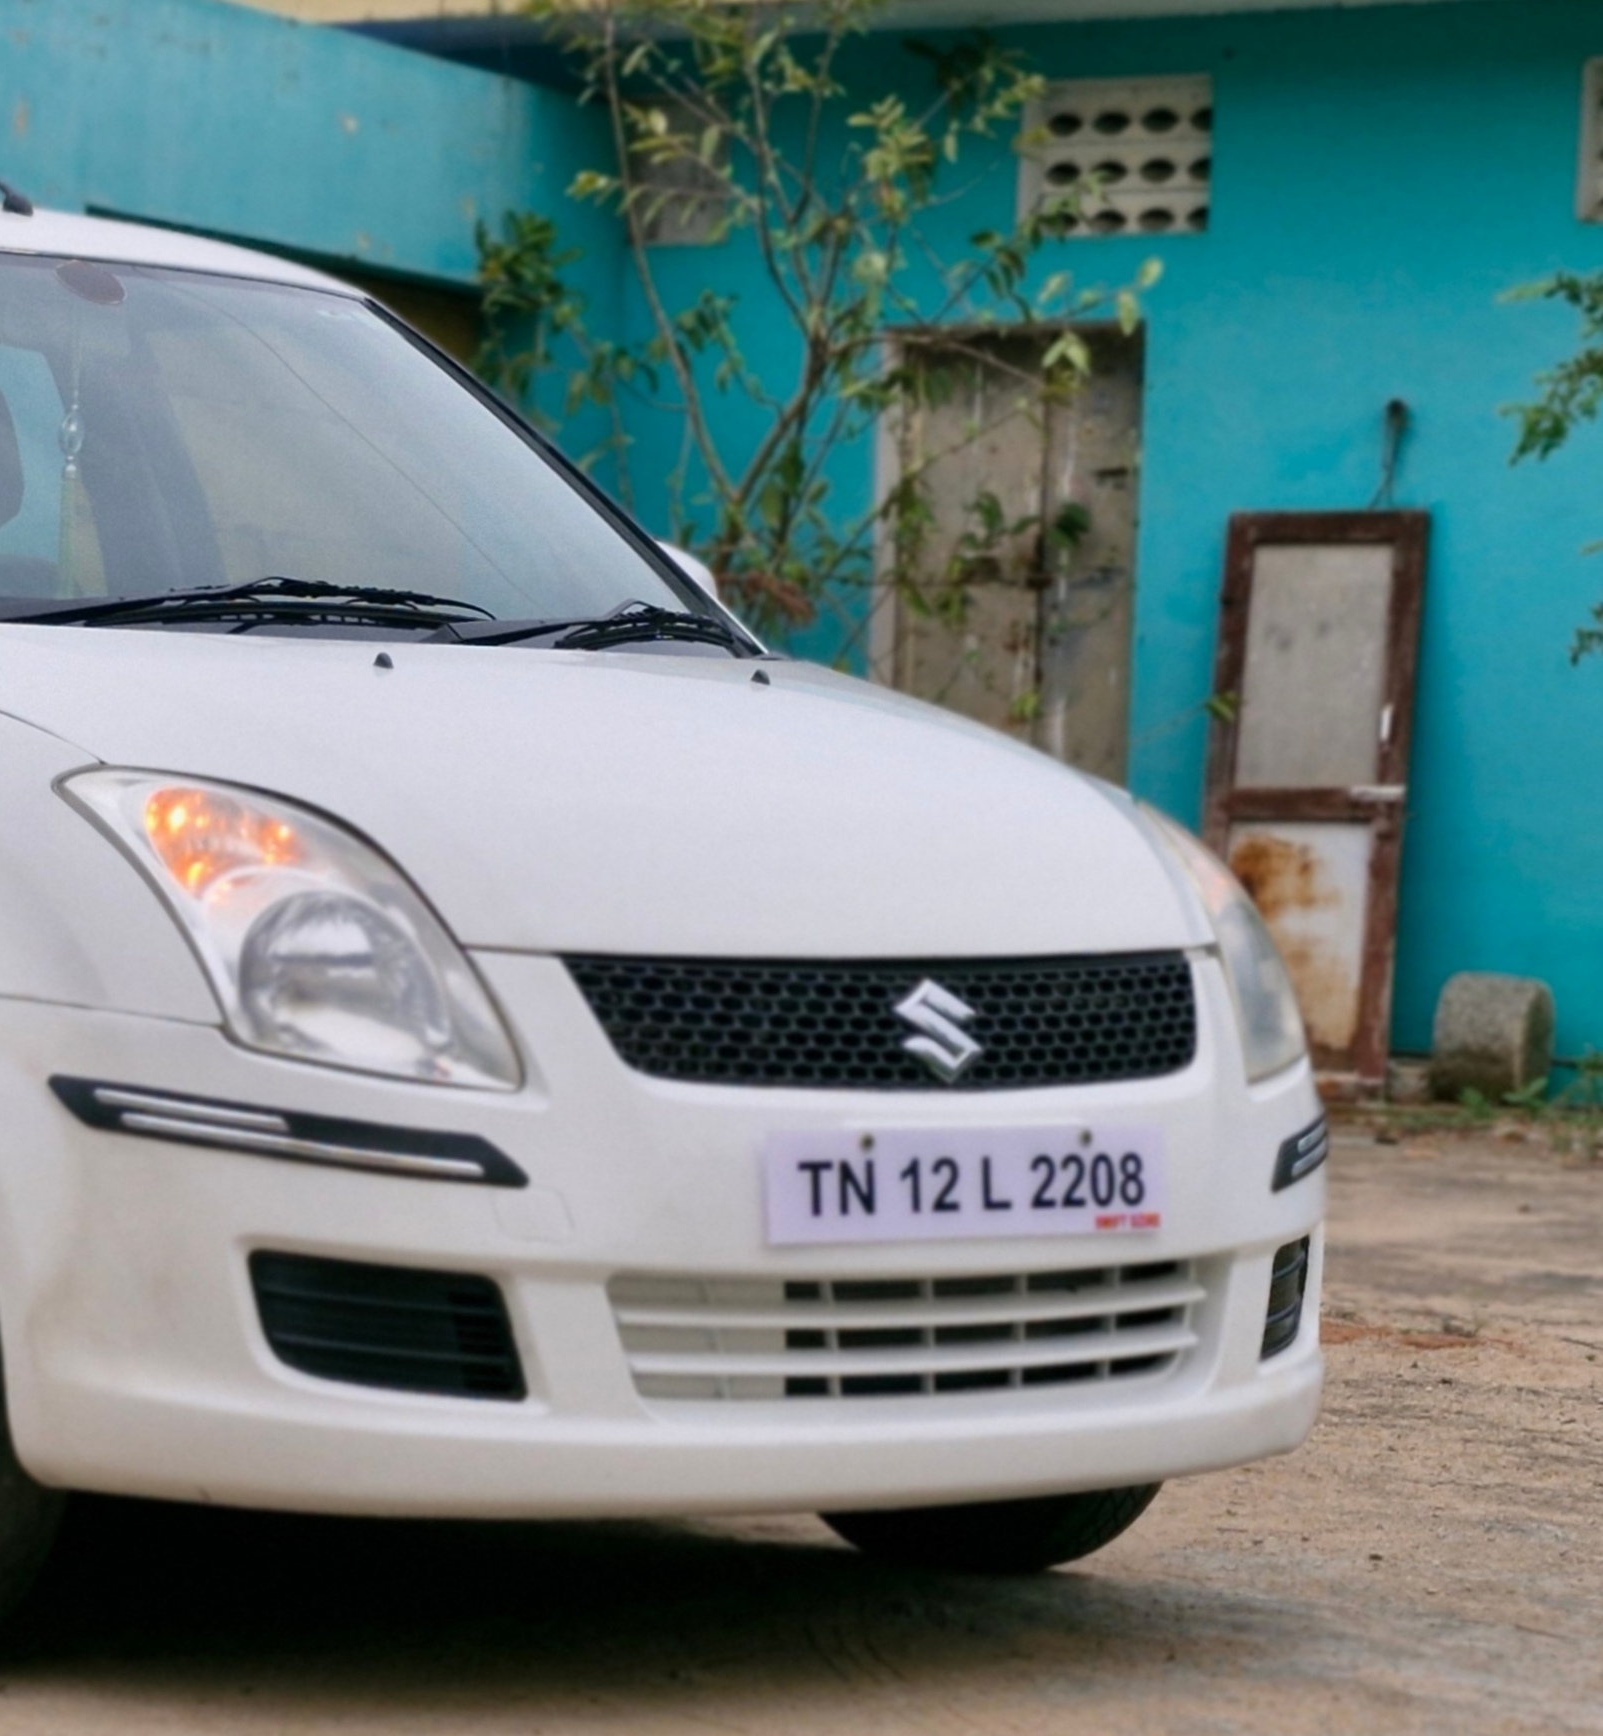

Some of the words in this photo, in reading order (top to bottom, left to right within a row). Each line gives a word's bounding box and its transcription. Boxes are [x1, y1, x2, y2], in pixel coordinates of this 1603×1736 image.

[798, 1159, 876, 1216] TN
[900, 1157, 961, 1213] 12
[981, 1155, 1013, 1211] L
[1030, 1152, 1145, 1209] 2208
